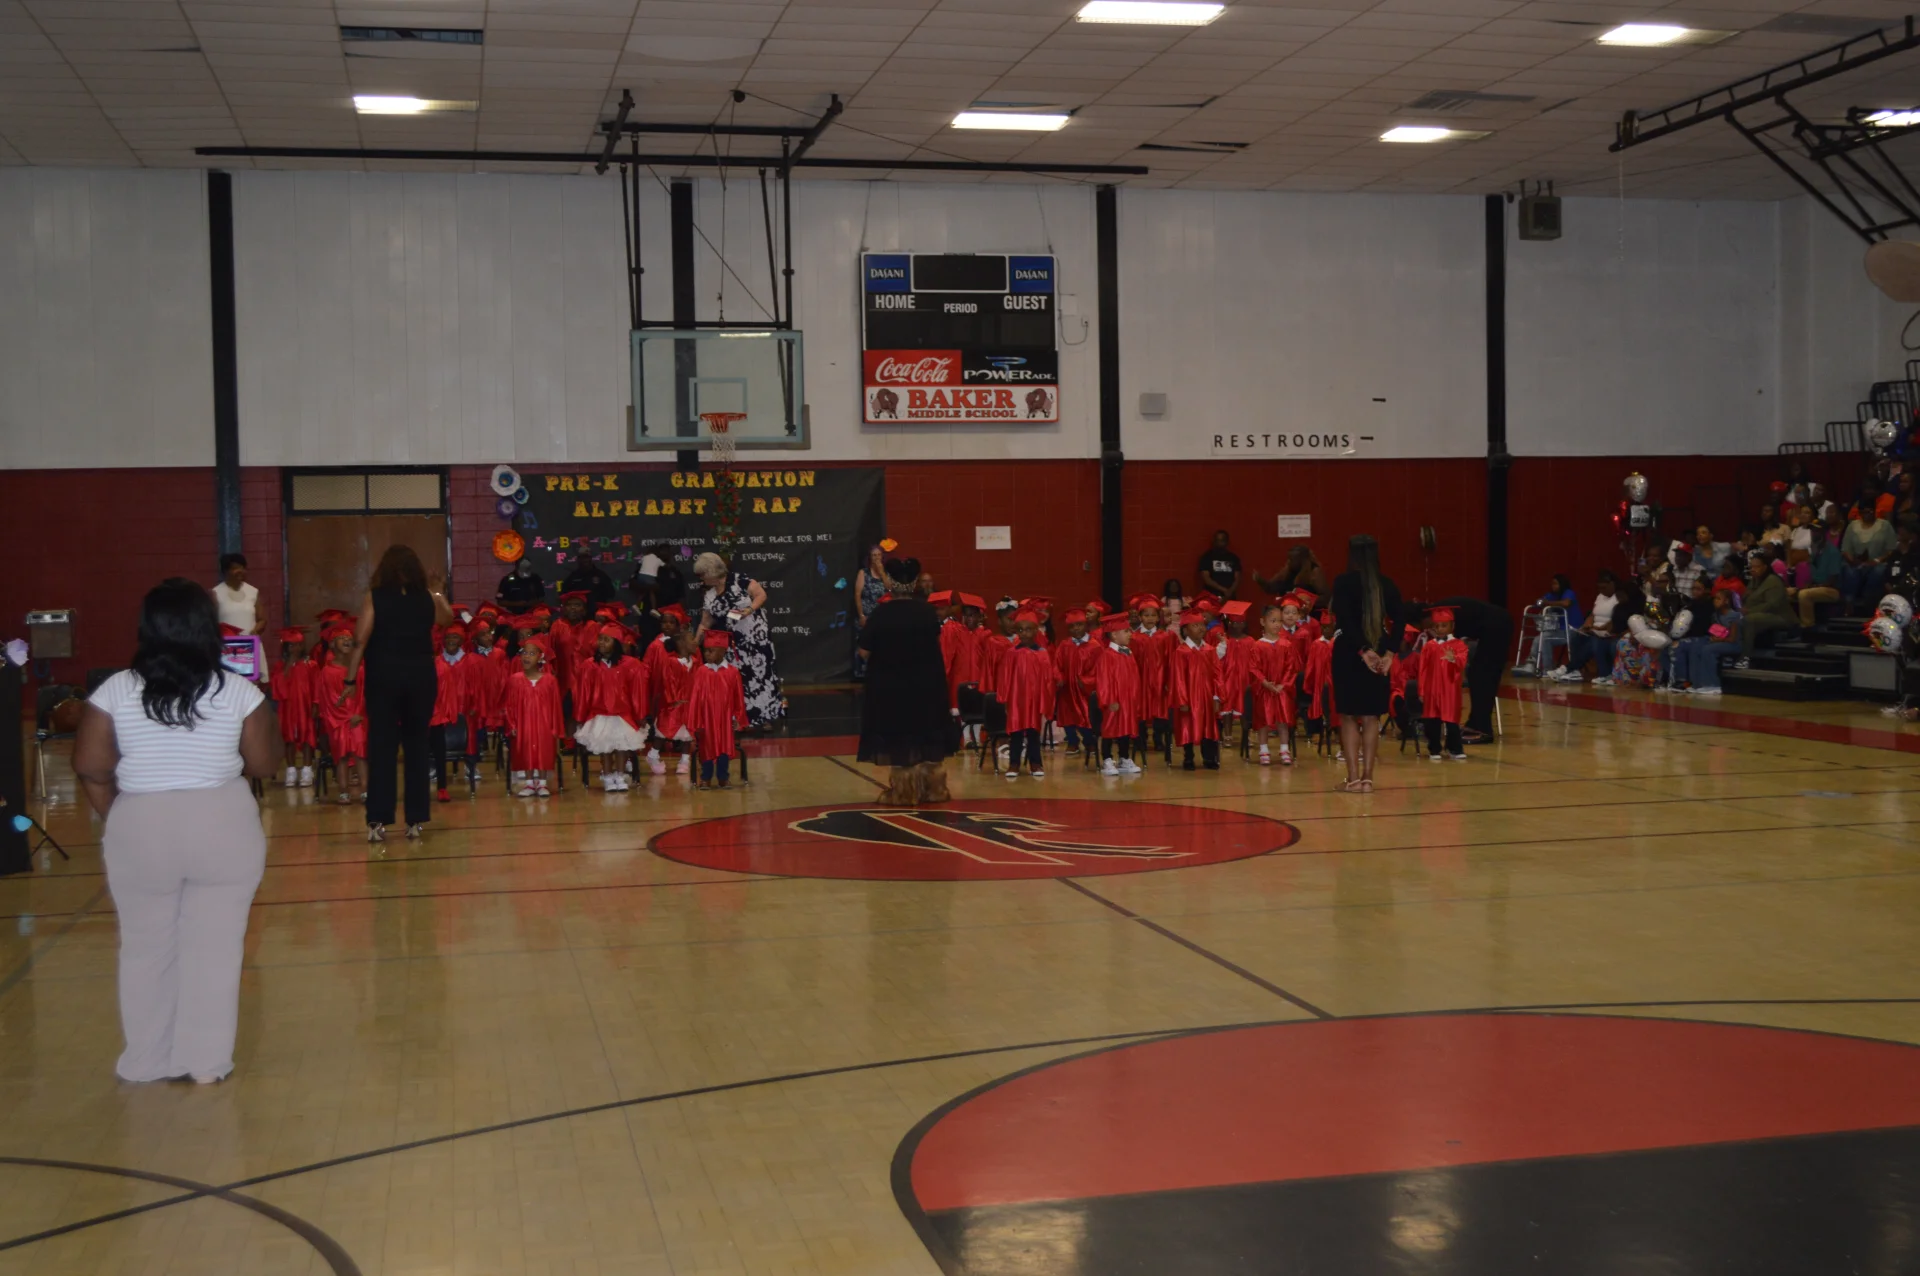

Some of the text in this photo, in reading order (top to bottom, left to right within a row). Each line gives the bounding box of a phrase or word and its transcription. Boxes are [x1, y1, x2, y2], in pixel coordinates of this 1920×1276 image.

[870, 268, 905, 279] DASANI
[1015, 269, 1048, 280] DASANI
[875, 294, 916, 309] HOME
[943, 303, 978, 314] PERIOD
[1003, 295, 1048, 310] GUEST
[875, 356, 954, 384] Coca-Cola
[906, 388, 1017, 409] BAKER
[907, 409, 1018, 418] MIDDLE SCHOOL
[1213, 434, 1350, 448] RESTROOMS
[544, 470, 816, 492] PRE-K GRAUATION
[572, 497, 802, 518] ALPHABET RAP
[749, 536, 765, 544] THE
[769, 535, 794, 543] PLACE
[796, 535, 813, 543] FOR
